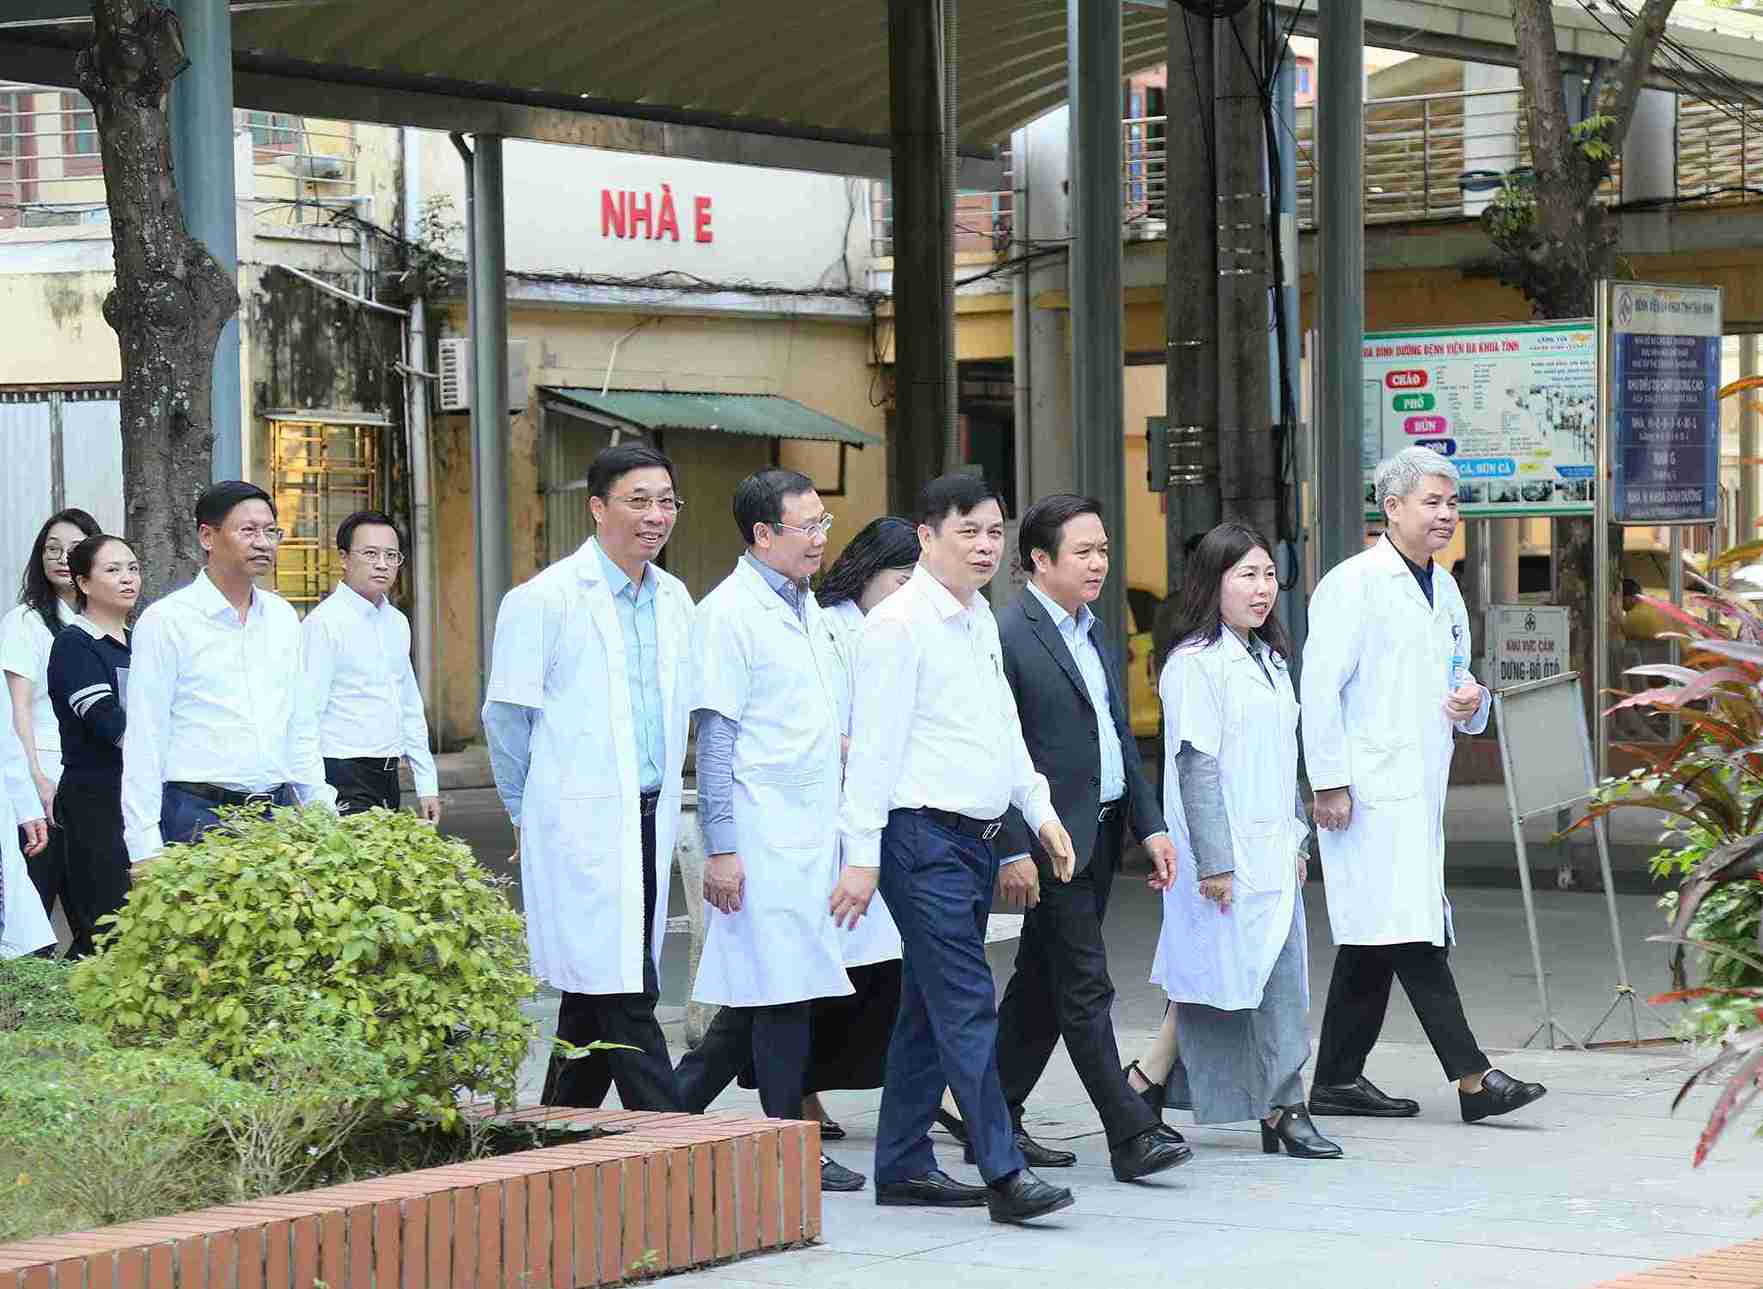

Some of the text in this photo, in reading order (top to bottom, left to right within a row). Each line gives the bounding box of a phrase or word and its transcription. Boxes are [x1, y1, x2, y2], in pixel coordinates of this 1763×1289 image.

[601, 183, 712, 243] NHÀ E
[1479, 341, 1500, 353] KHOA
[1392, 372, 1420, 385] CHÁO
[1404, 395, 1424, 409] PHỞ
[1415, 417, 1436, 431] BÚN
[1498, 461, 1511, 473] CÁ
[1506, 640, 1520, 651] KHU
[1521, 640, 1537, 652] VỰC
